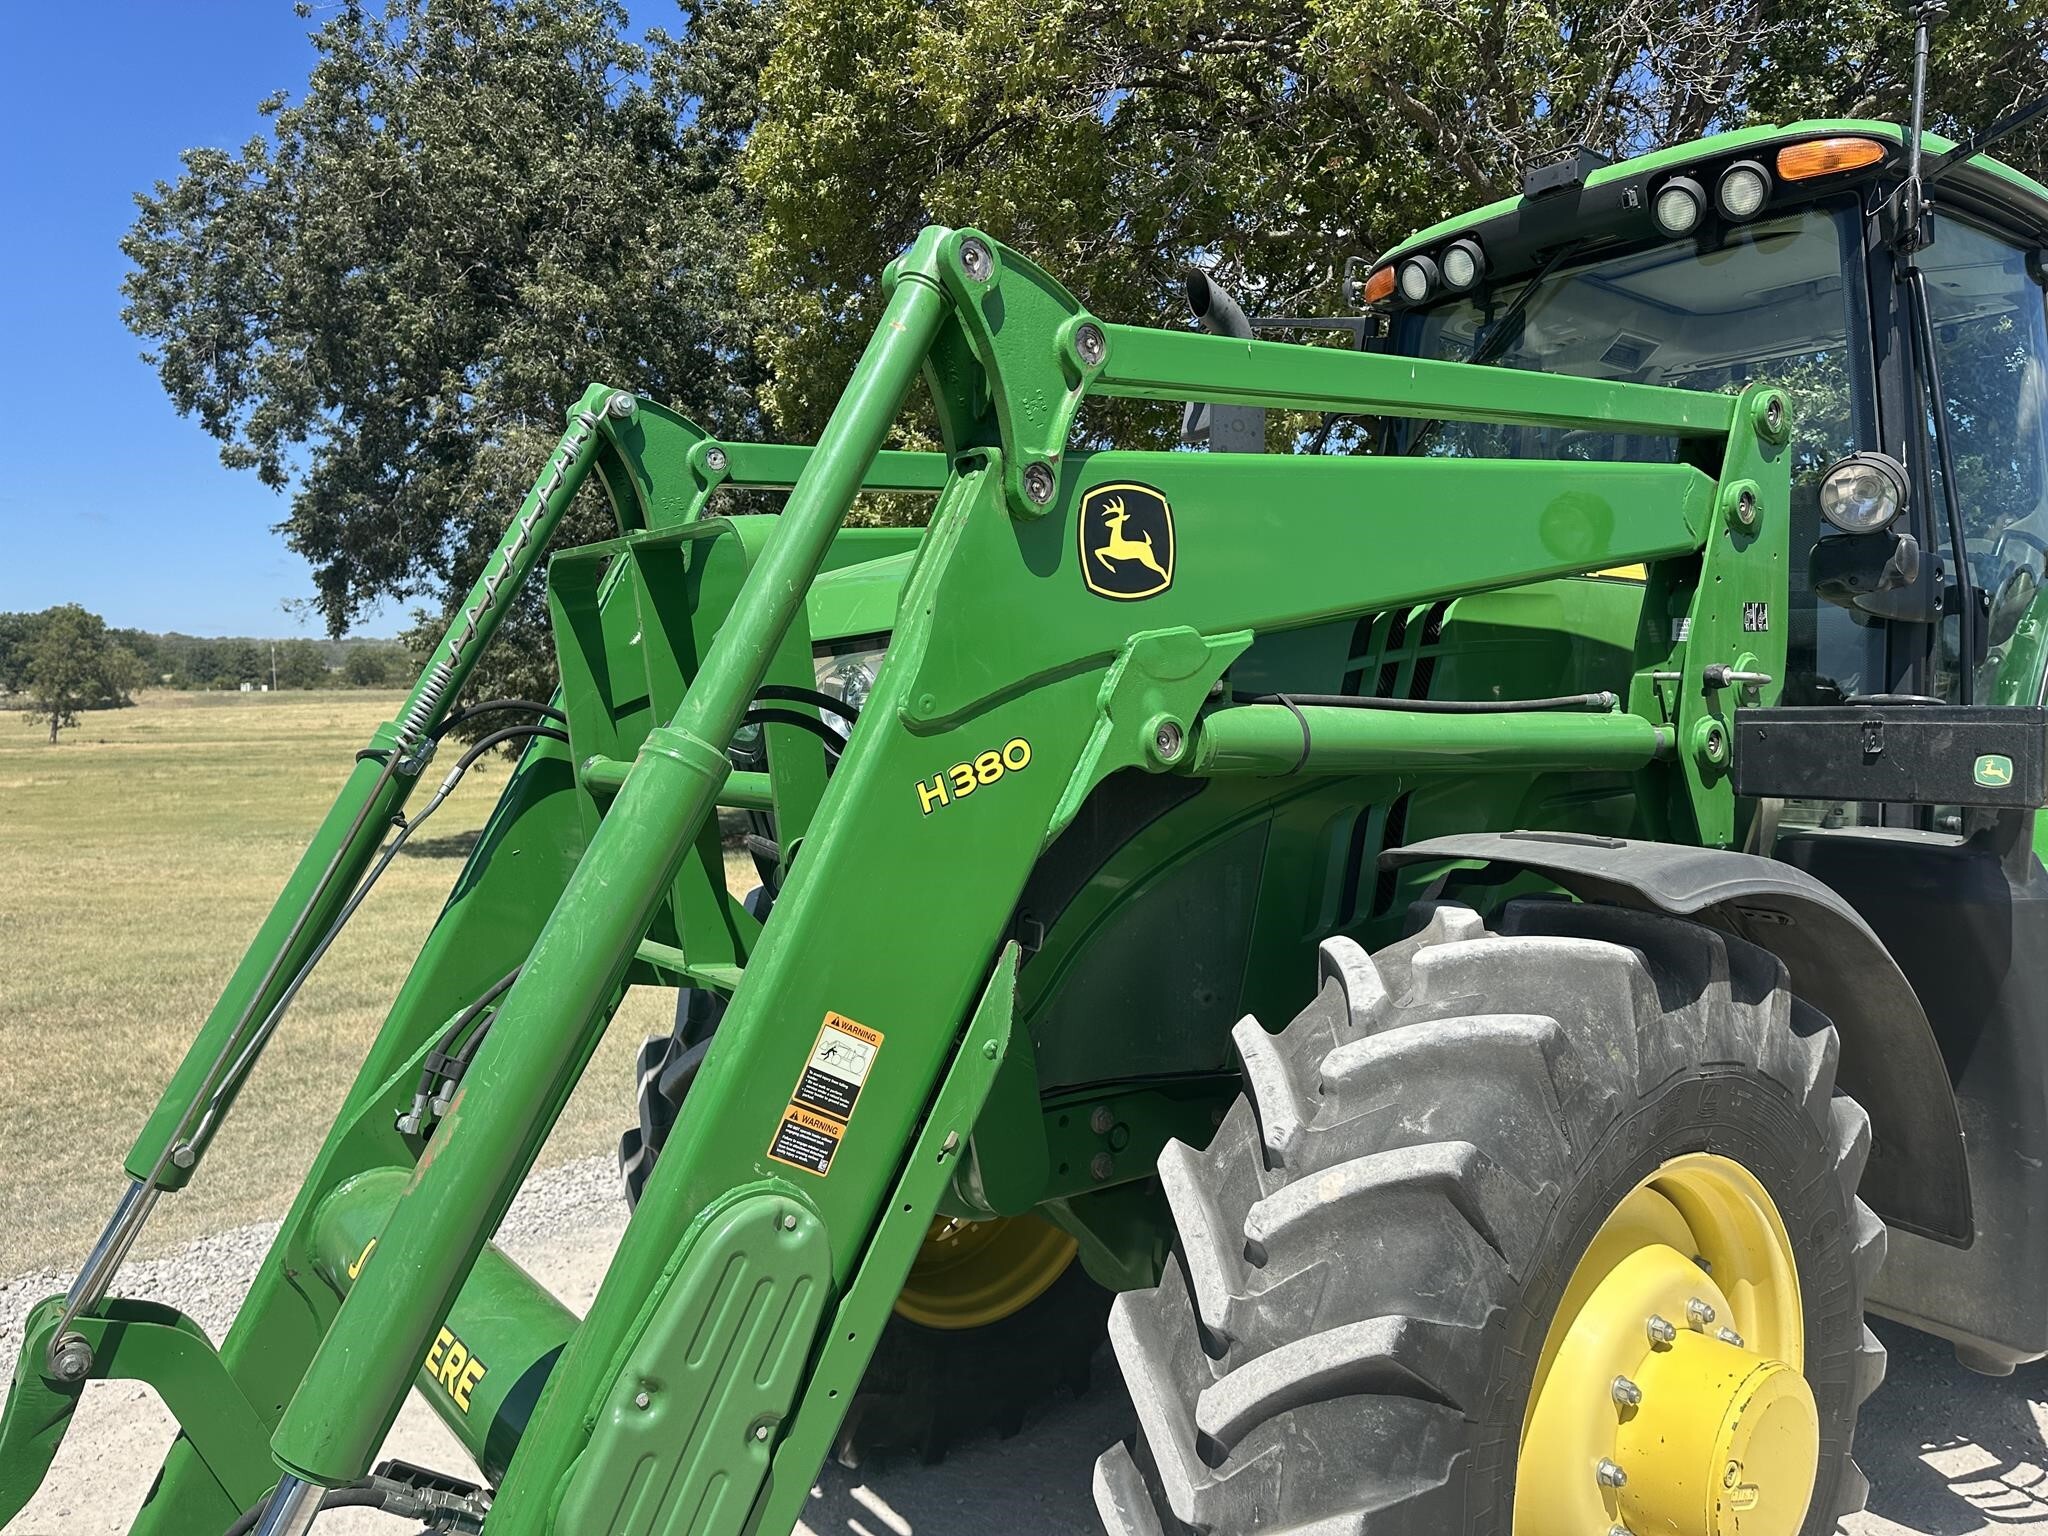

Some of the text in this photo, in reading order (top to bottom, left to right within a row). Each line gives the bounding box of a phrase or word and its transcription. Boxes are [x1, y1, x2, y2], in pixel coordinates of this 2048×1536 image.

[915, 737, 1032, 815] H380
[840, 1020, 877, 1042] WARNING
[801, 1114, 839, 1135] WARNING
[423, 1325, 487, 1415] ERE
